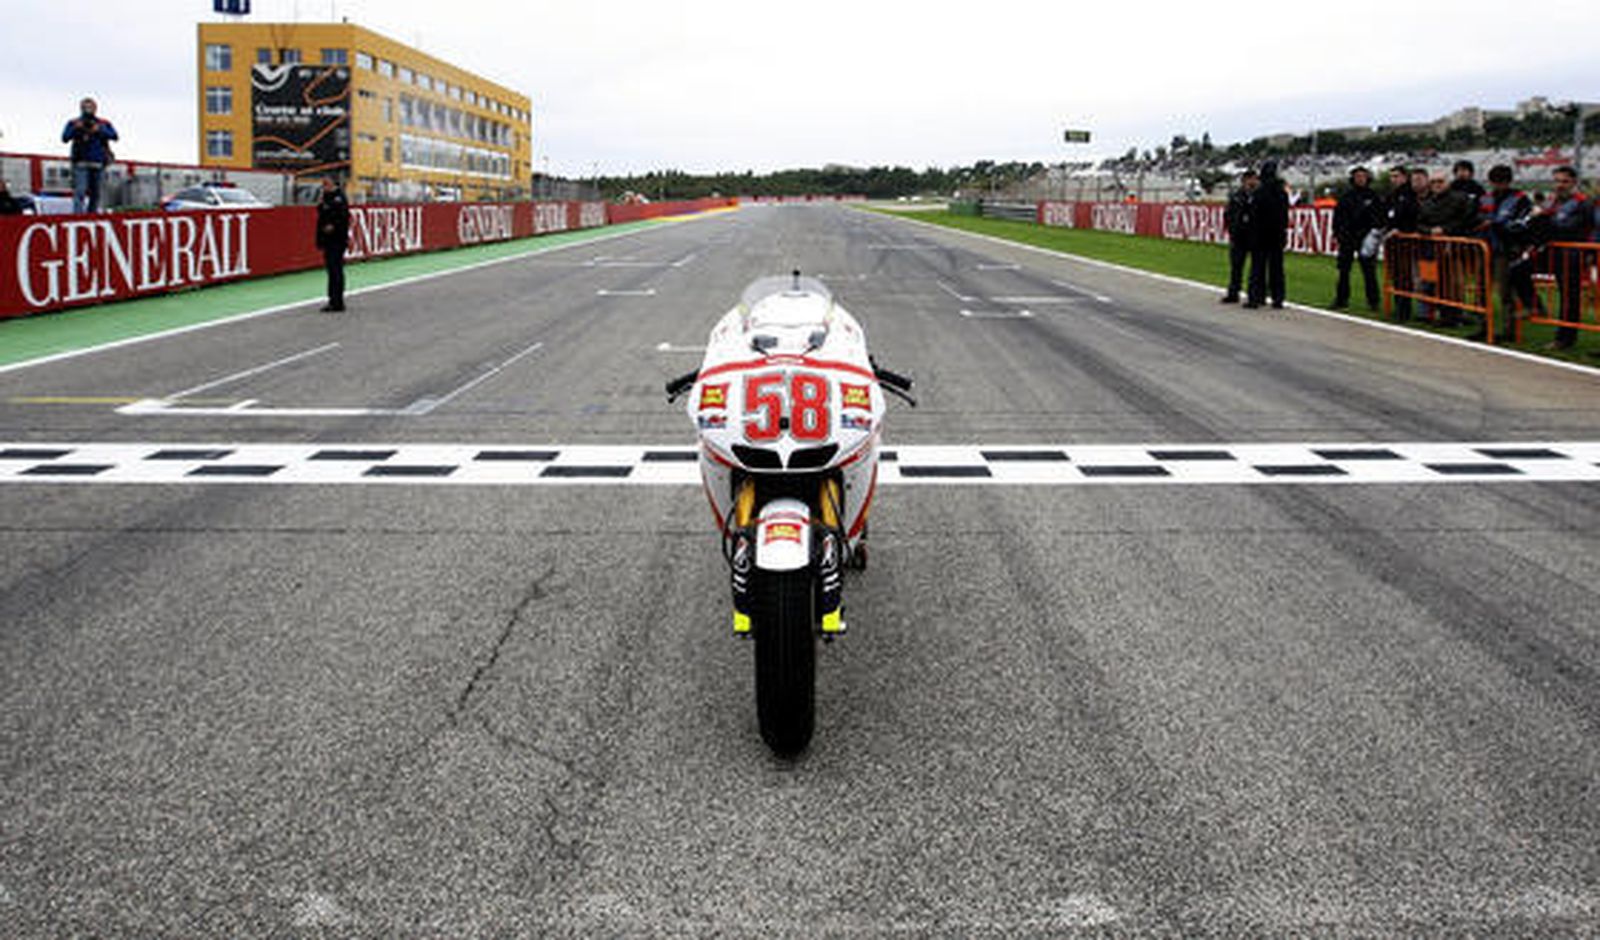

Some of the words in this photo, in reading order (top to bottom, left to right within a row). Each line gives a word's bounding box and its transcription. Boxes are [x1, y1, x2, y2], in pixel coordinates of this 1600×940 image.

[1162, 205, 1230, 243] GENERAL
[17, 213, 250, 307] GENERALI
[743, 371, 831, 442] 58
